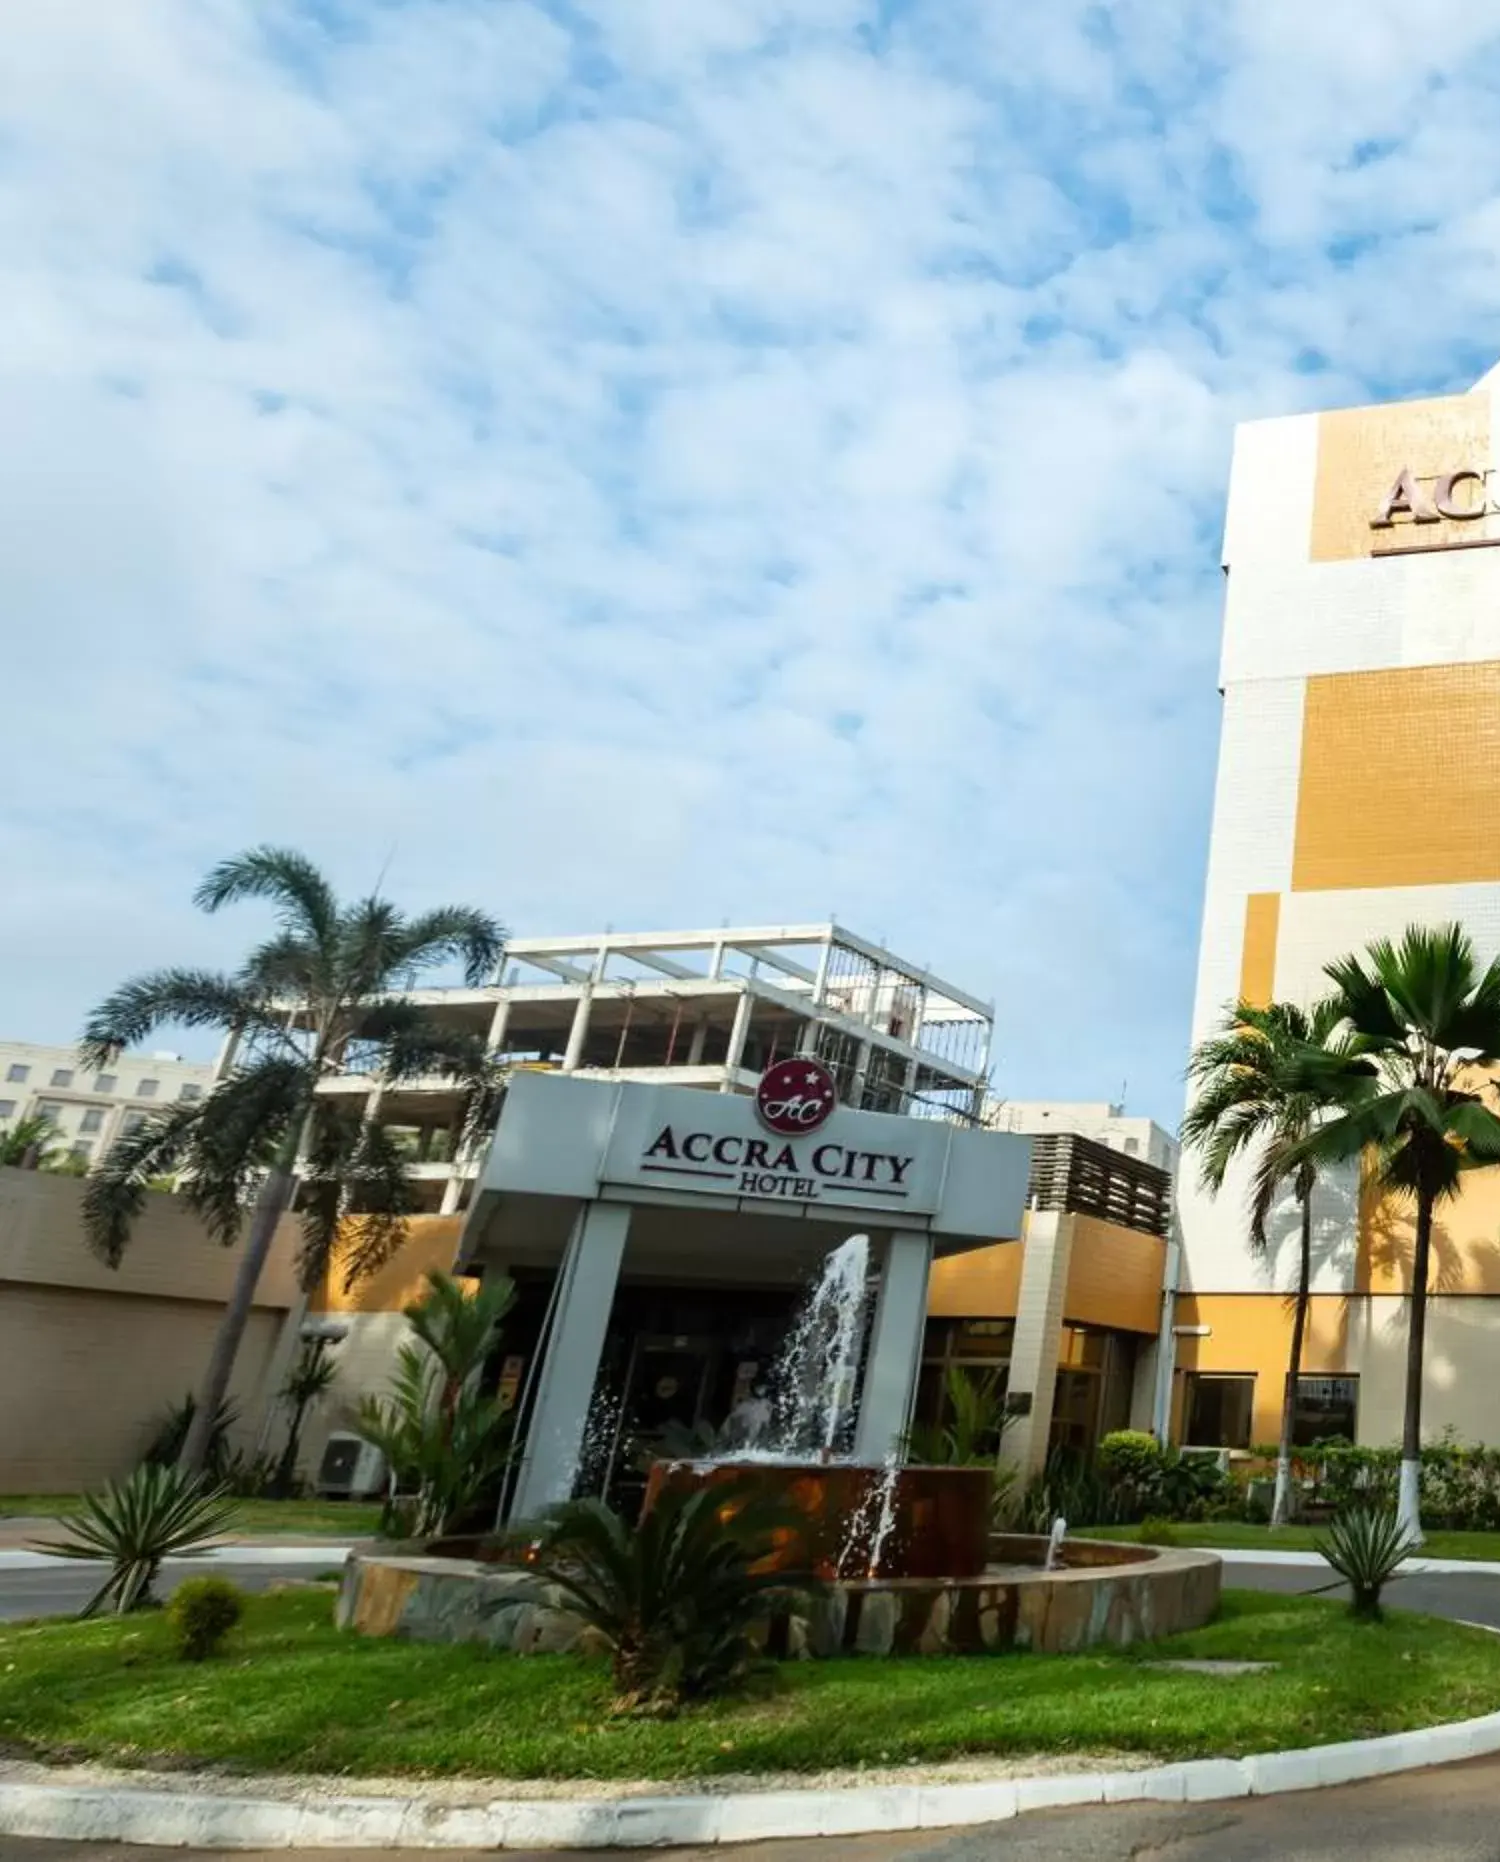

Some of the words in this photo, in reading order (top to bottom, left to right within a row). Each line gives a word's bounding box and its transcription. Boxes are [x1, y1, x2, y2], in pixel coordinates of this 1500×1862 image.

[763, 1095, 824, 1124] AC
[643, 1125, 798, 1173] ACCRA
[811, 1144, 915, 1184] CITY
[738, 1171, 821, 1199] HOTEL
